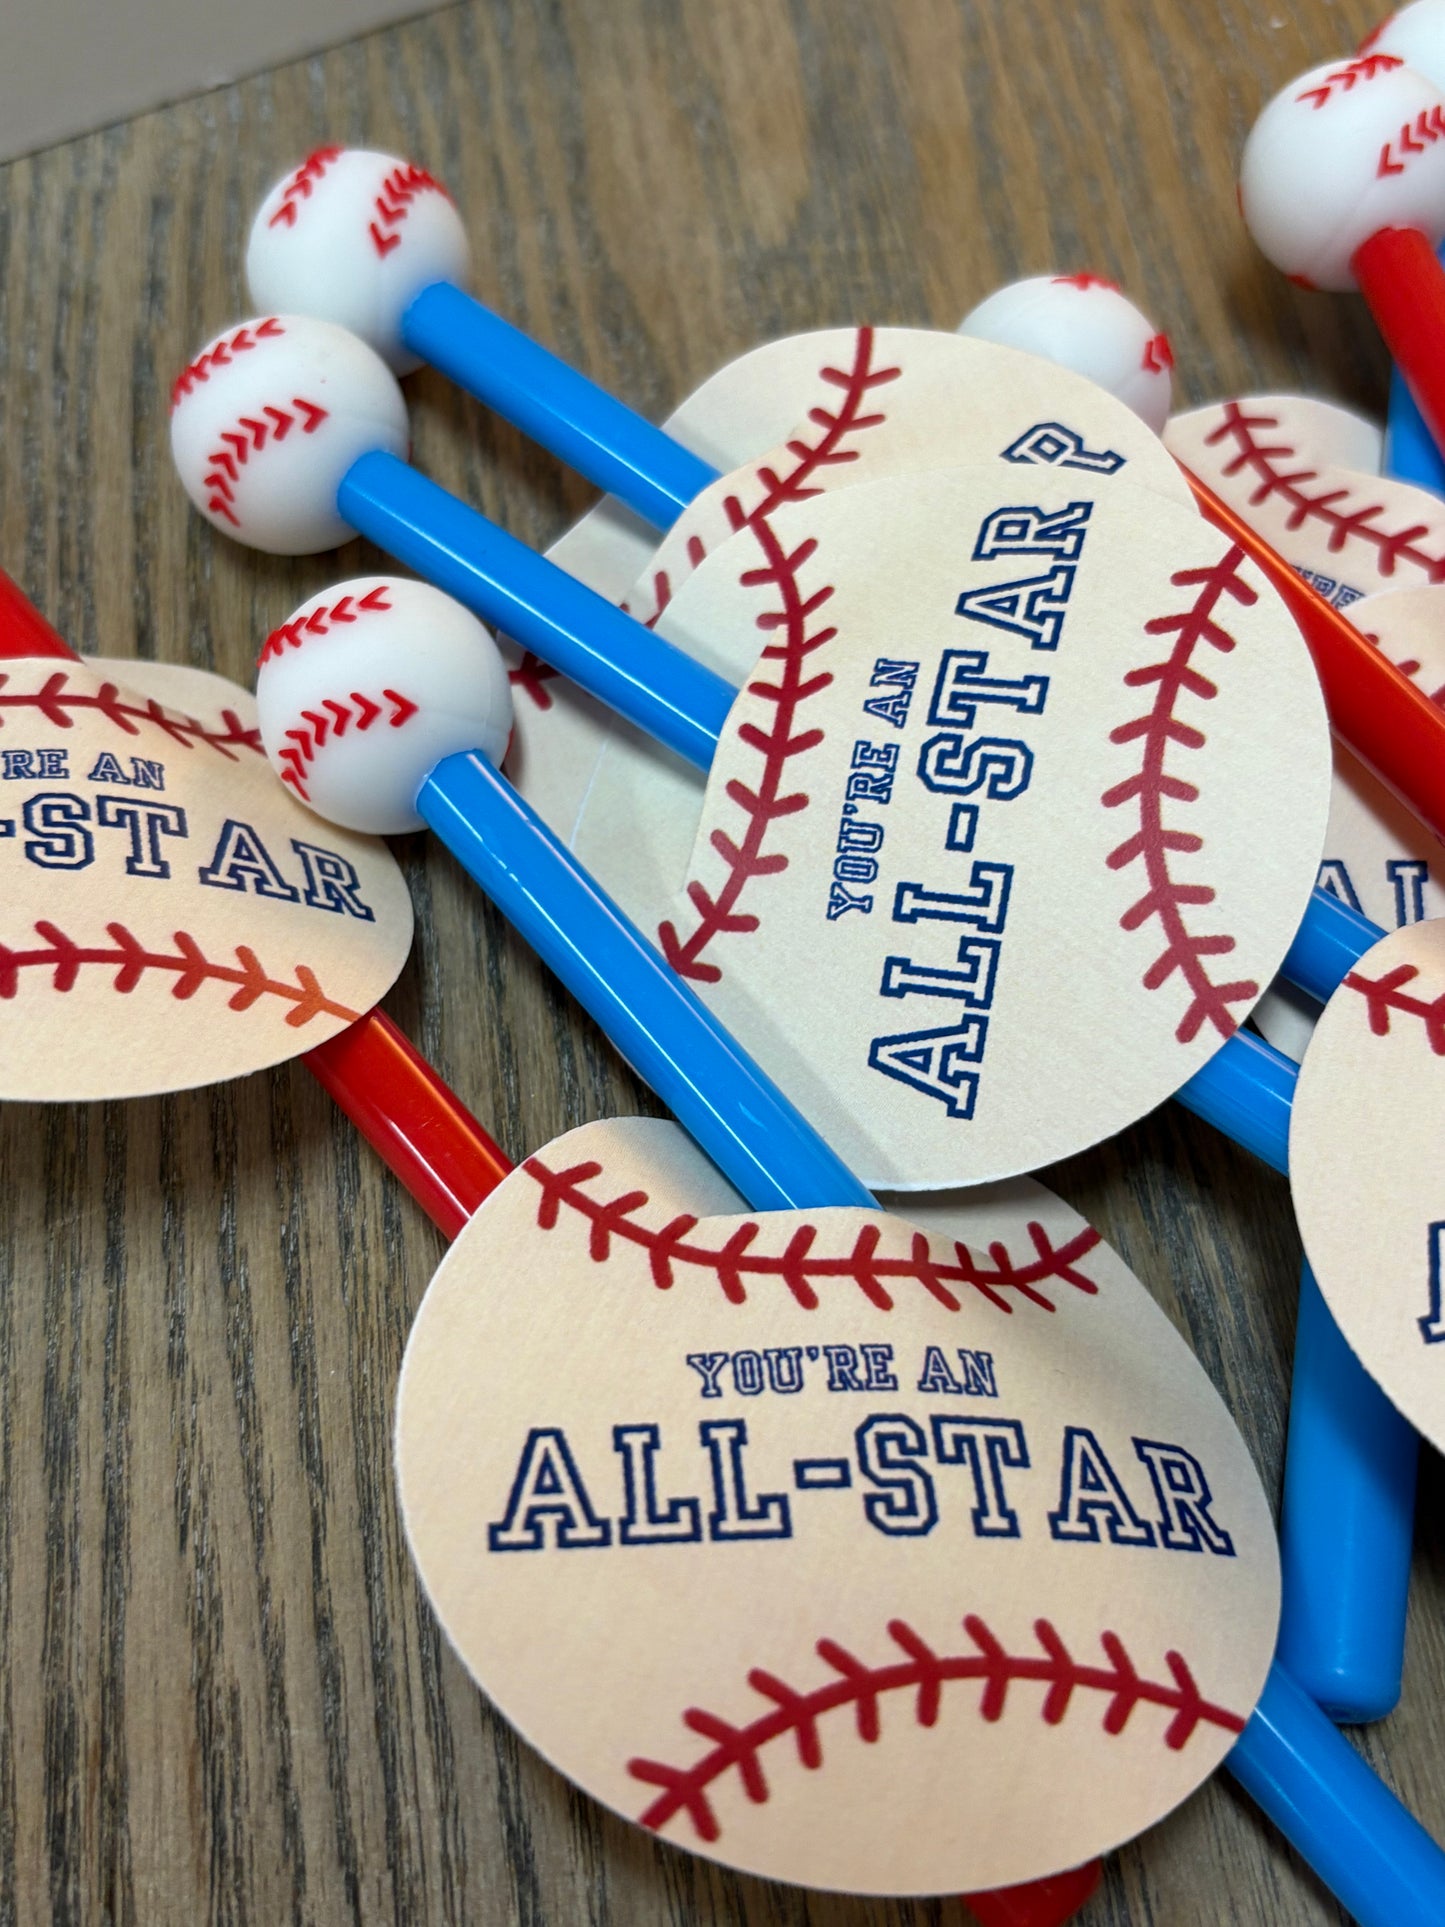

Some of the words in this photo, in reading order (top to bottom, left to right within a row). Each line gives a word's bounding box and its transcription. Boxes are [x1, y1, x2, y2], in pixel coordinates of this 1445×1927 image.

[88, 752, 165, 792] AN
[826, 740, 900, 921] YOU'RE
[863, 657, 920, 730] AN
[868, 501, 1095, 1121] ALL-STAR
[686, 1344, 899, 1399] YOU'RE
[918, 1346, 999, 1398] AN
[488, 1413, 1238, 1558] ALL-STAR
